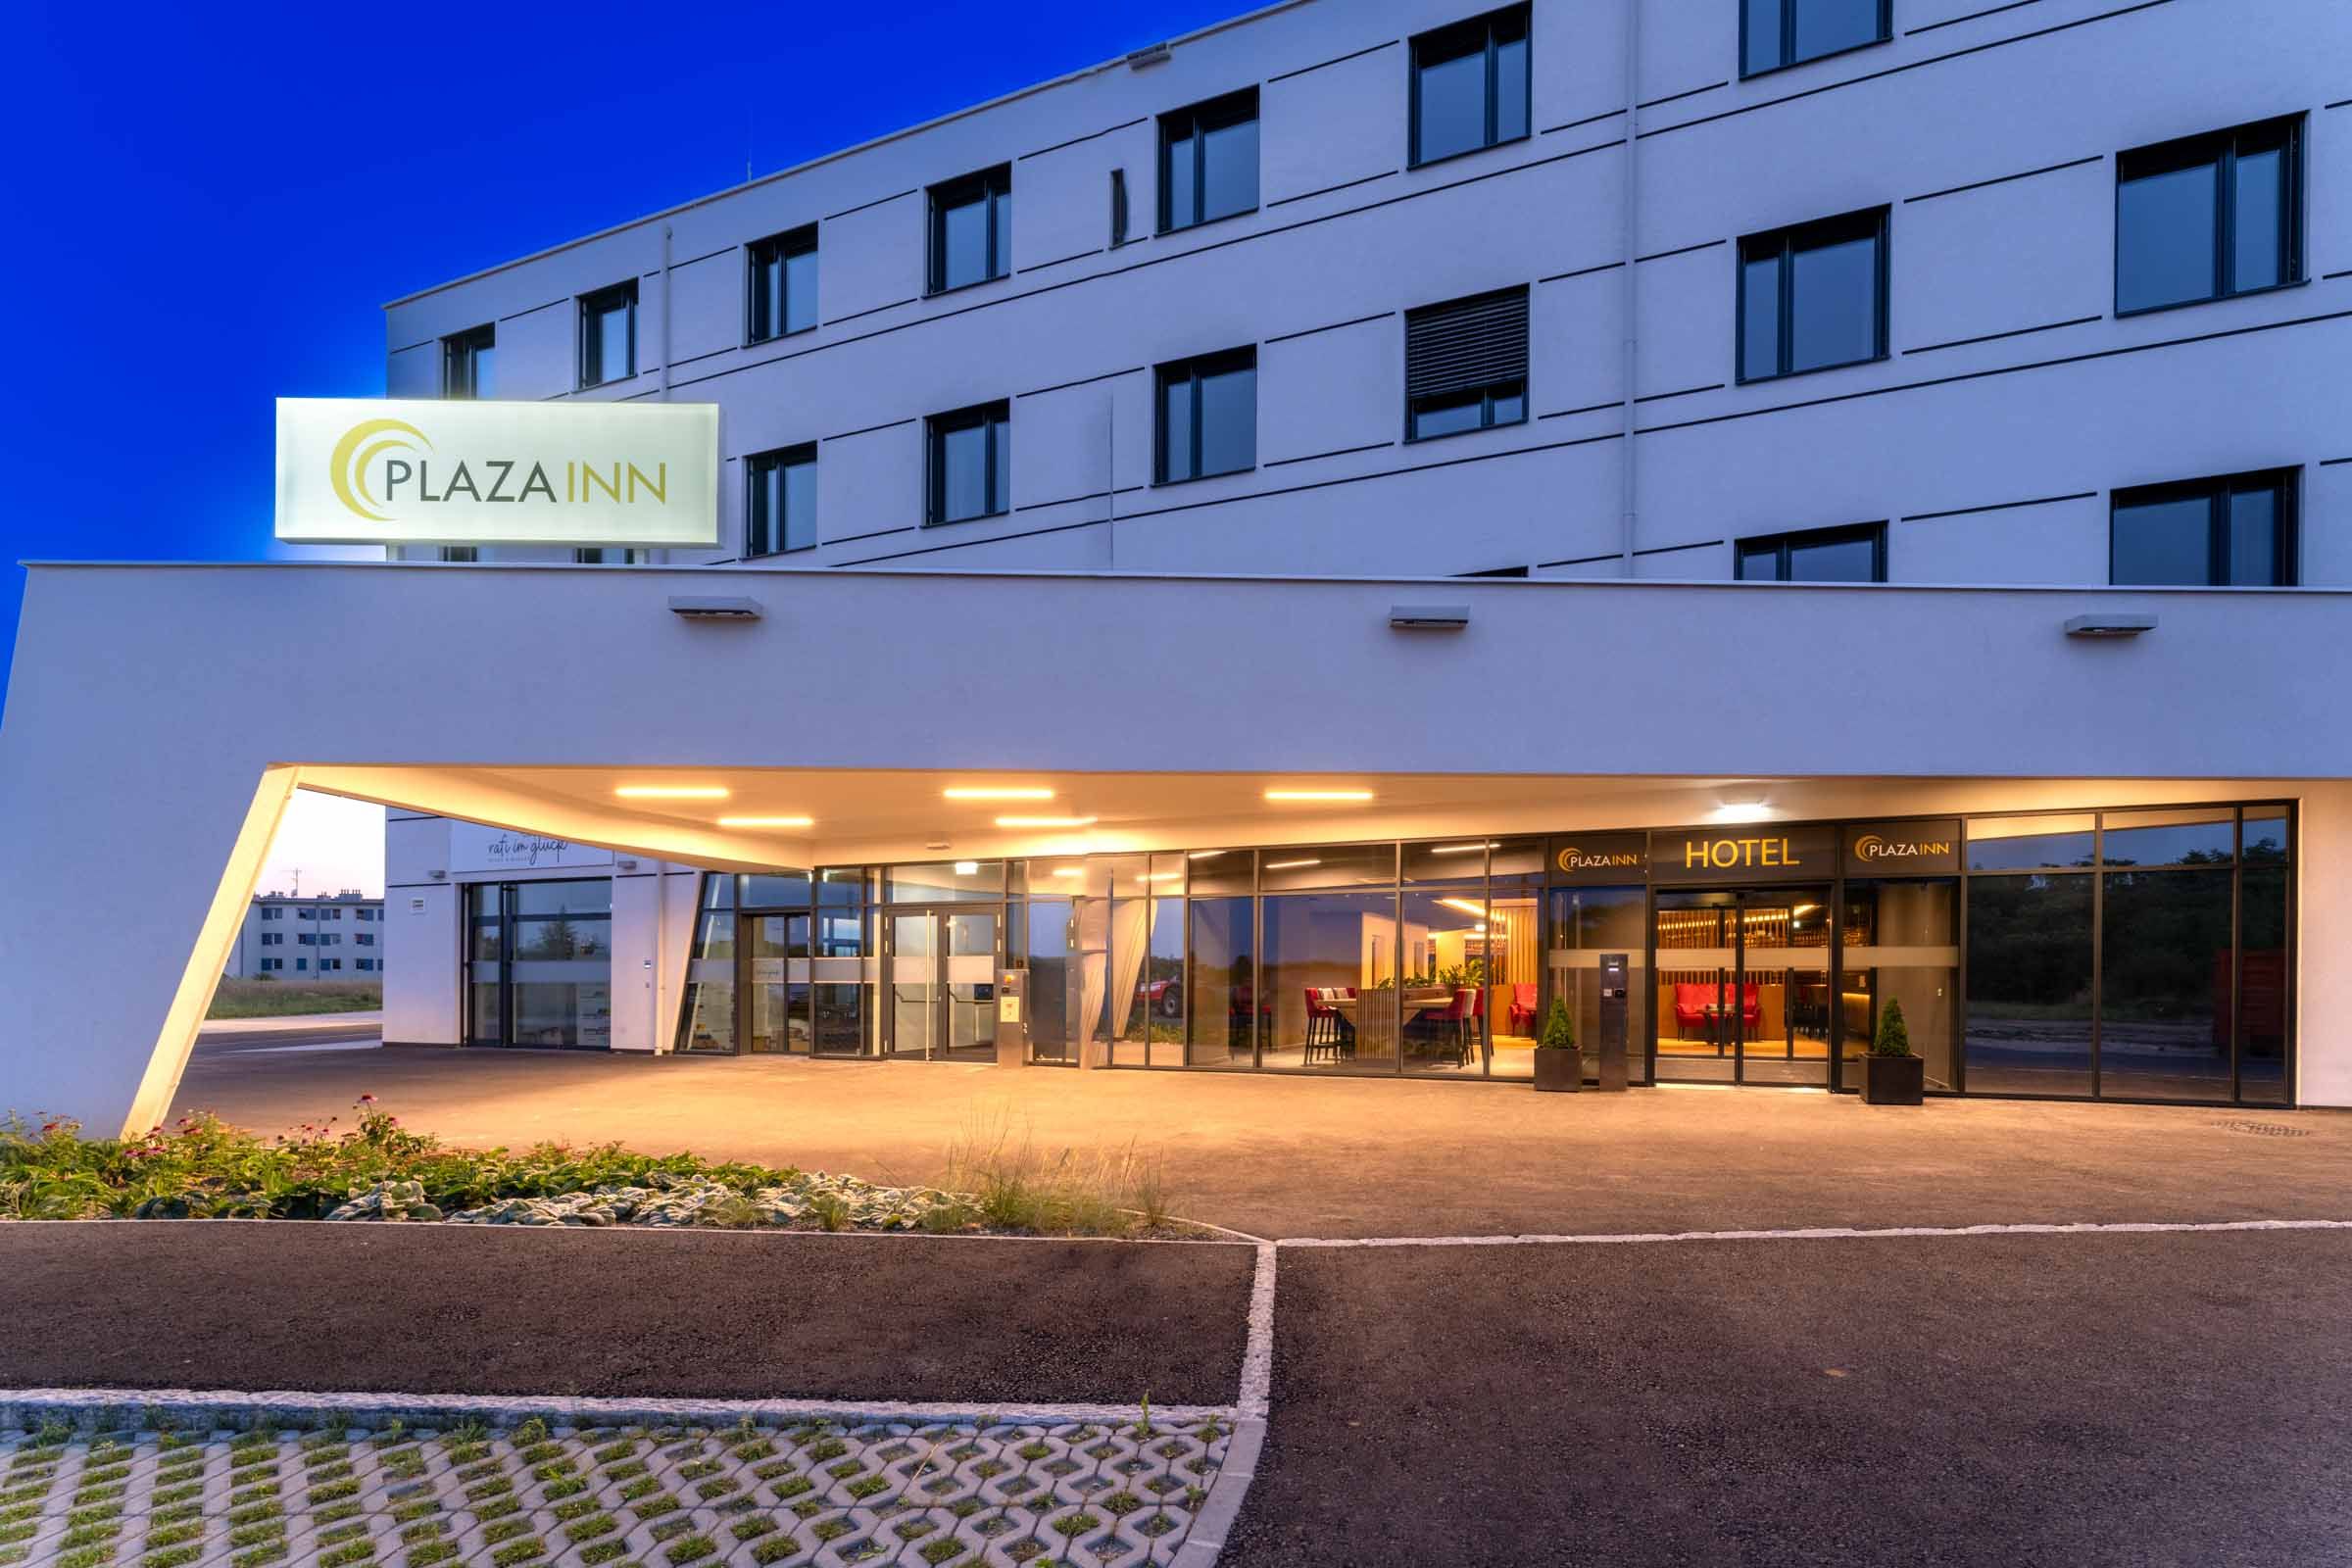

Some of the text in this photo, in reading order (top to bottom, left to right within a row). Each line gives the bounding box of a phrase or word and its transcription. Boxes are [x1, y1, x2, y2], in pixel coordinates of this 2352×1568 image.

[385, 460, 666, 504] PLAZA INN
[1570, 854, 1638, 867] PLAZA INN
[1685, 838, 1800, 868] HOTEL
[1869, 842, 1949, 857] PLAZA INN
